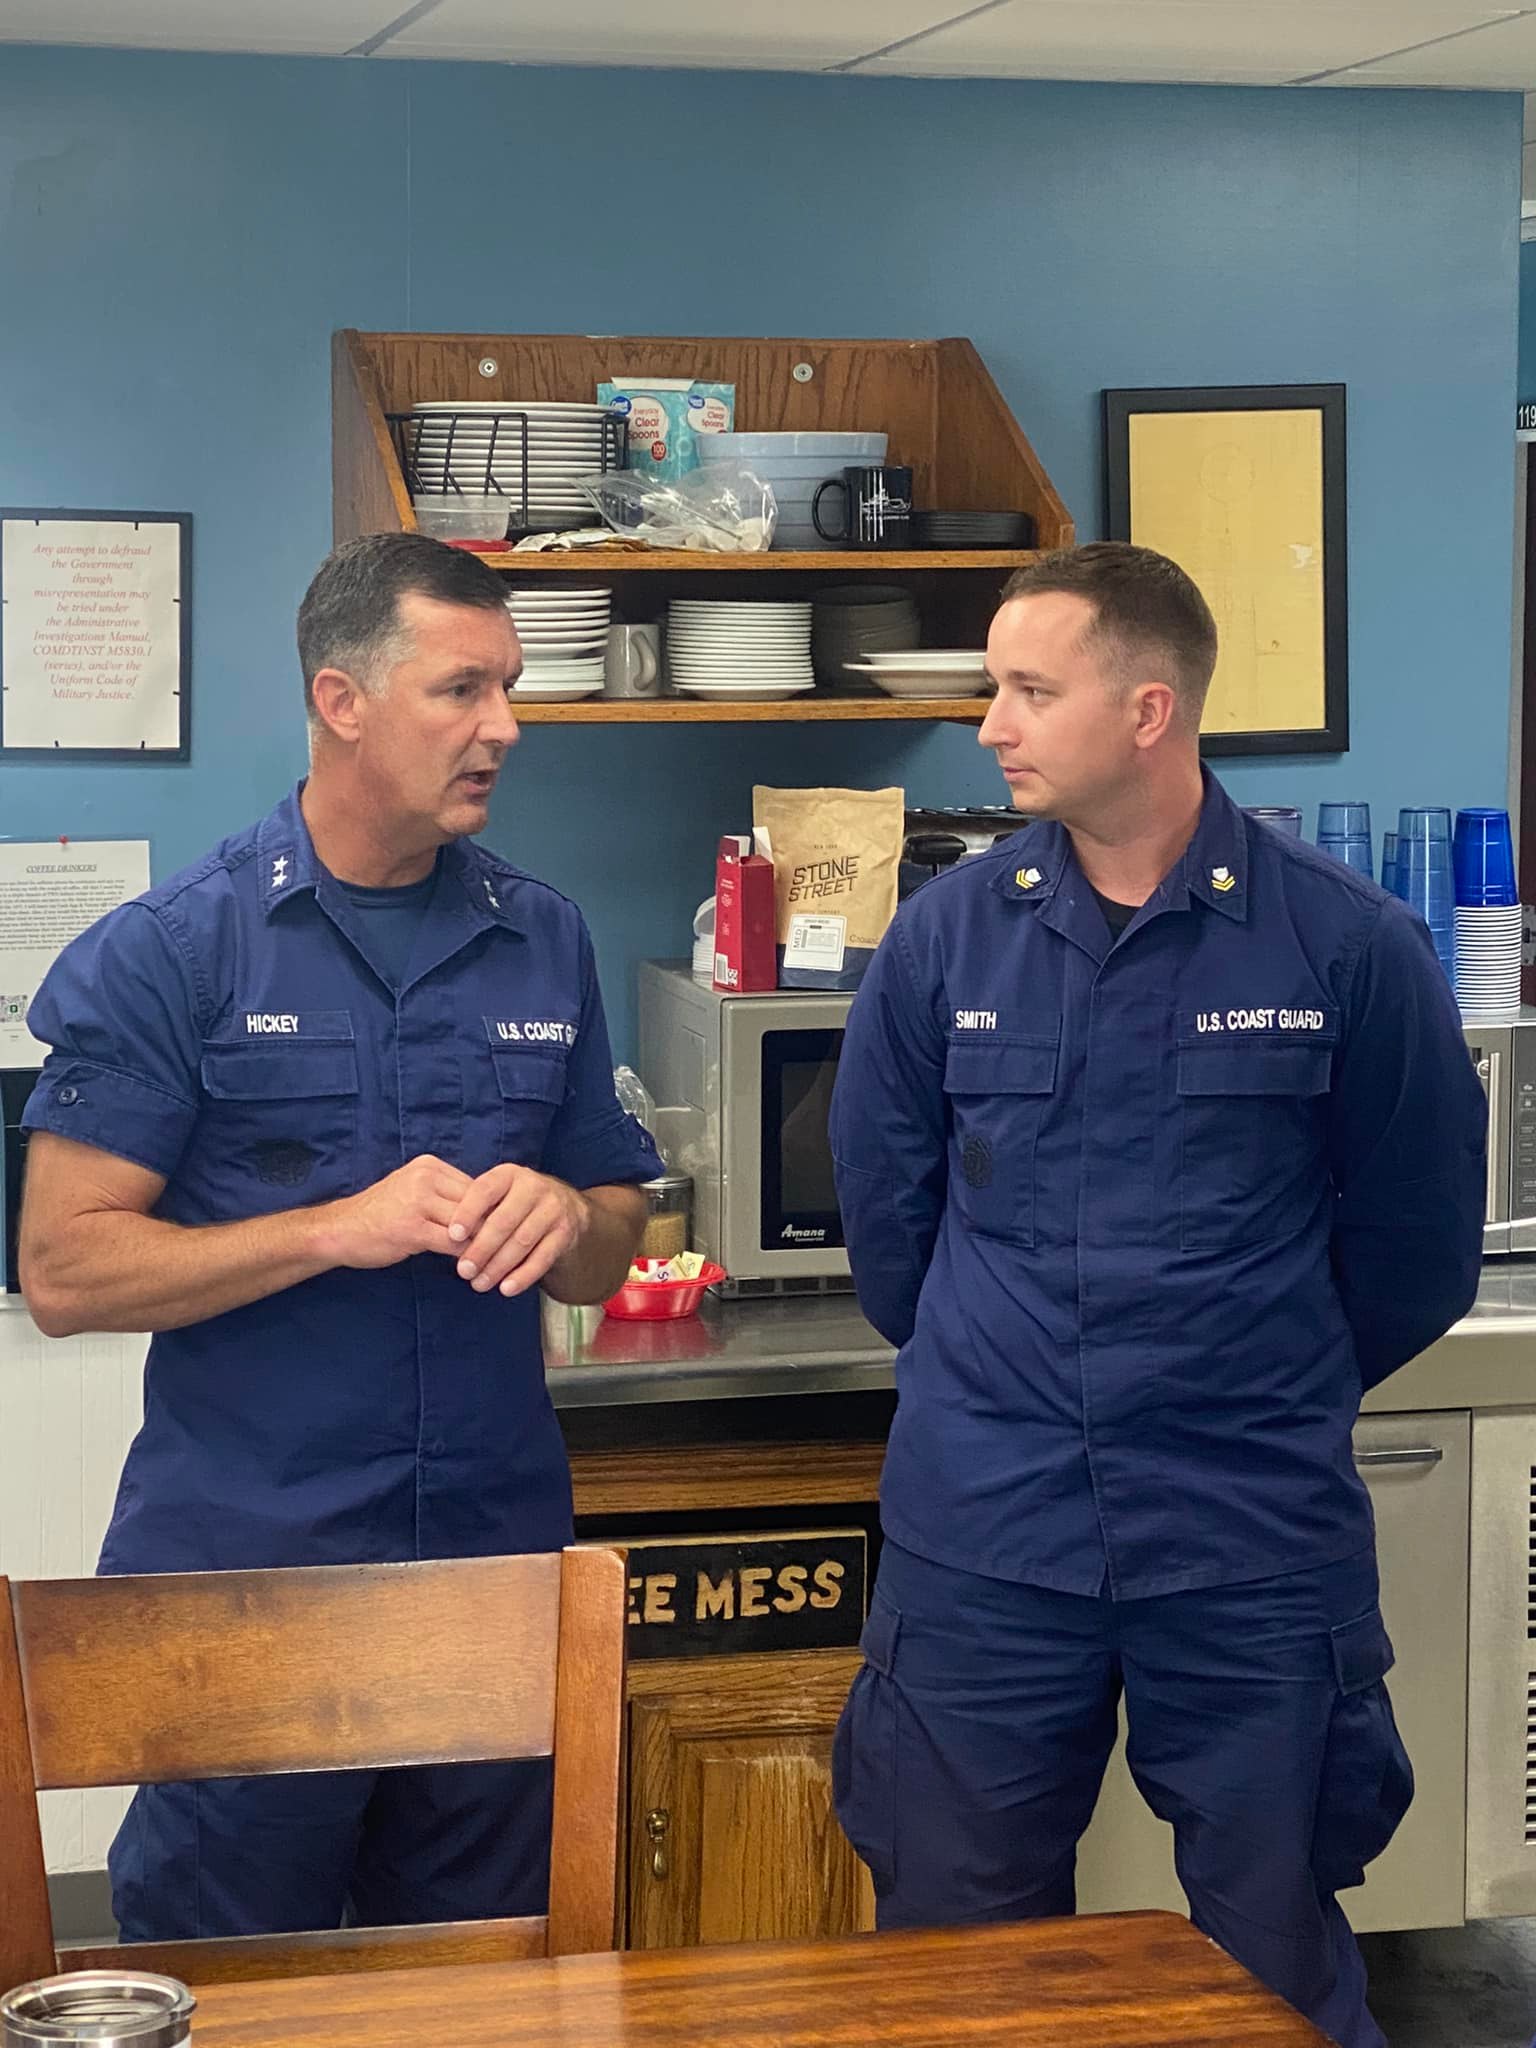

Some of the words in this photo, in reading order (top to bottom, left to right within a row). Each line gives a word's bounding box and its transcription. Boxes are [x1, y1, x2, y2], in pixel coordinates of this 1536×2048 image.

[707, 411, 725, 420] Clear
[635, 417, 659, 427] Clear
[627, 430, 659, 441] Spoons
[33, 544, 52, 556] Any
[56, 545, 96, 557] attempt
[98, 545, 109, 554] to
[110, 544, 152, 557] defraud
[51, 559, 67, 569] the
[70, 559, 133, 570] Government
[72, 573, 113, 585] through
[33, 588, 127, 600] misrepresentation
[129, 590, 152, 601] may
[57, 601, 69, 612] be
[71, 602, 97, 613] tried
[99, 602, 129, 613] under
[46, 616, 61, 627] the
[64, 616, 140, 627] Administrative
[33, 631, 105, 643] Investigations
[32, 646, 105, 656] COMDTINST
[126, 661, 142, 671] the
[50, 674, 93, 686] Uniform
[96, 674, 123, 685] Code
[126, 675, 136, 687] of
[51, 688, 93, 700] Military
[26, 864, 56, 873] COFFEE
[57, 864, 97, 873] DRINKERS
[792, 855, 860, 886] STONE
[788, 875, 857, 903] STREET
[246, 1014, 299, 1034] HICKEY
[955, 1009, 997, 1030] SMITH
[1197, 1012, 1225, 1033] U.S.
[1227, 1009, 1276, 1031] COAST
[1278, 1008, 1324, 1031] GUARD
[497, 1022, 524, 1041] U.S.
[525, 1023, 564, 1042] COAST
[780, 1223, 826, 1238] Amana
[695, 1559, 845, 1621] MESS
